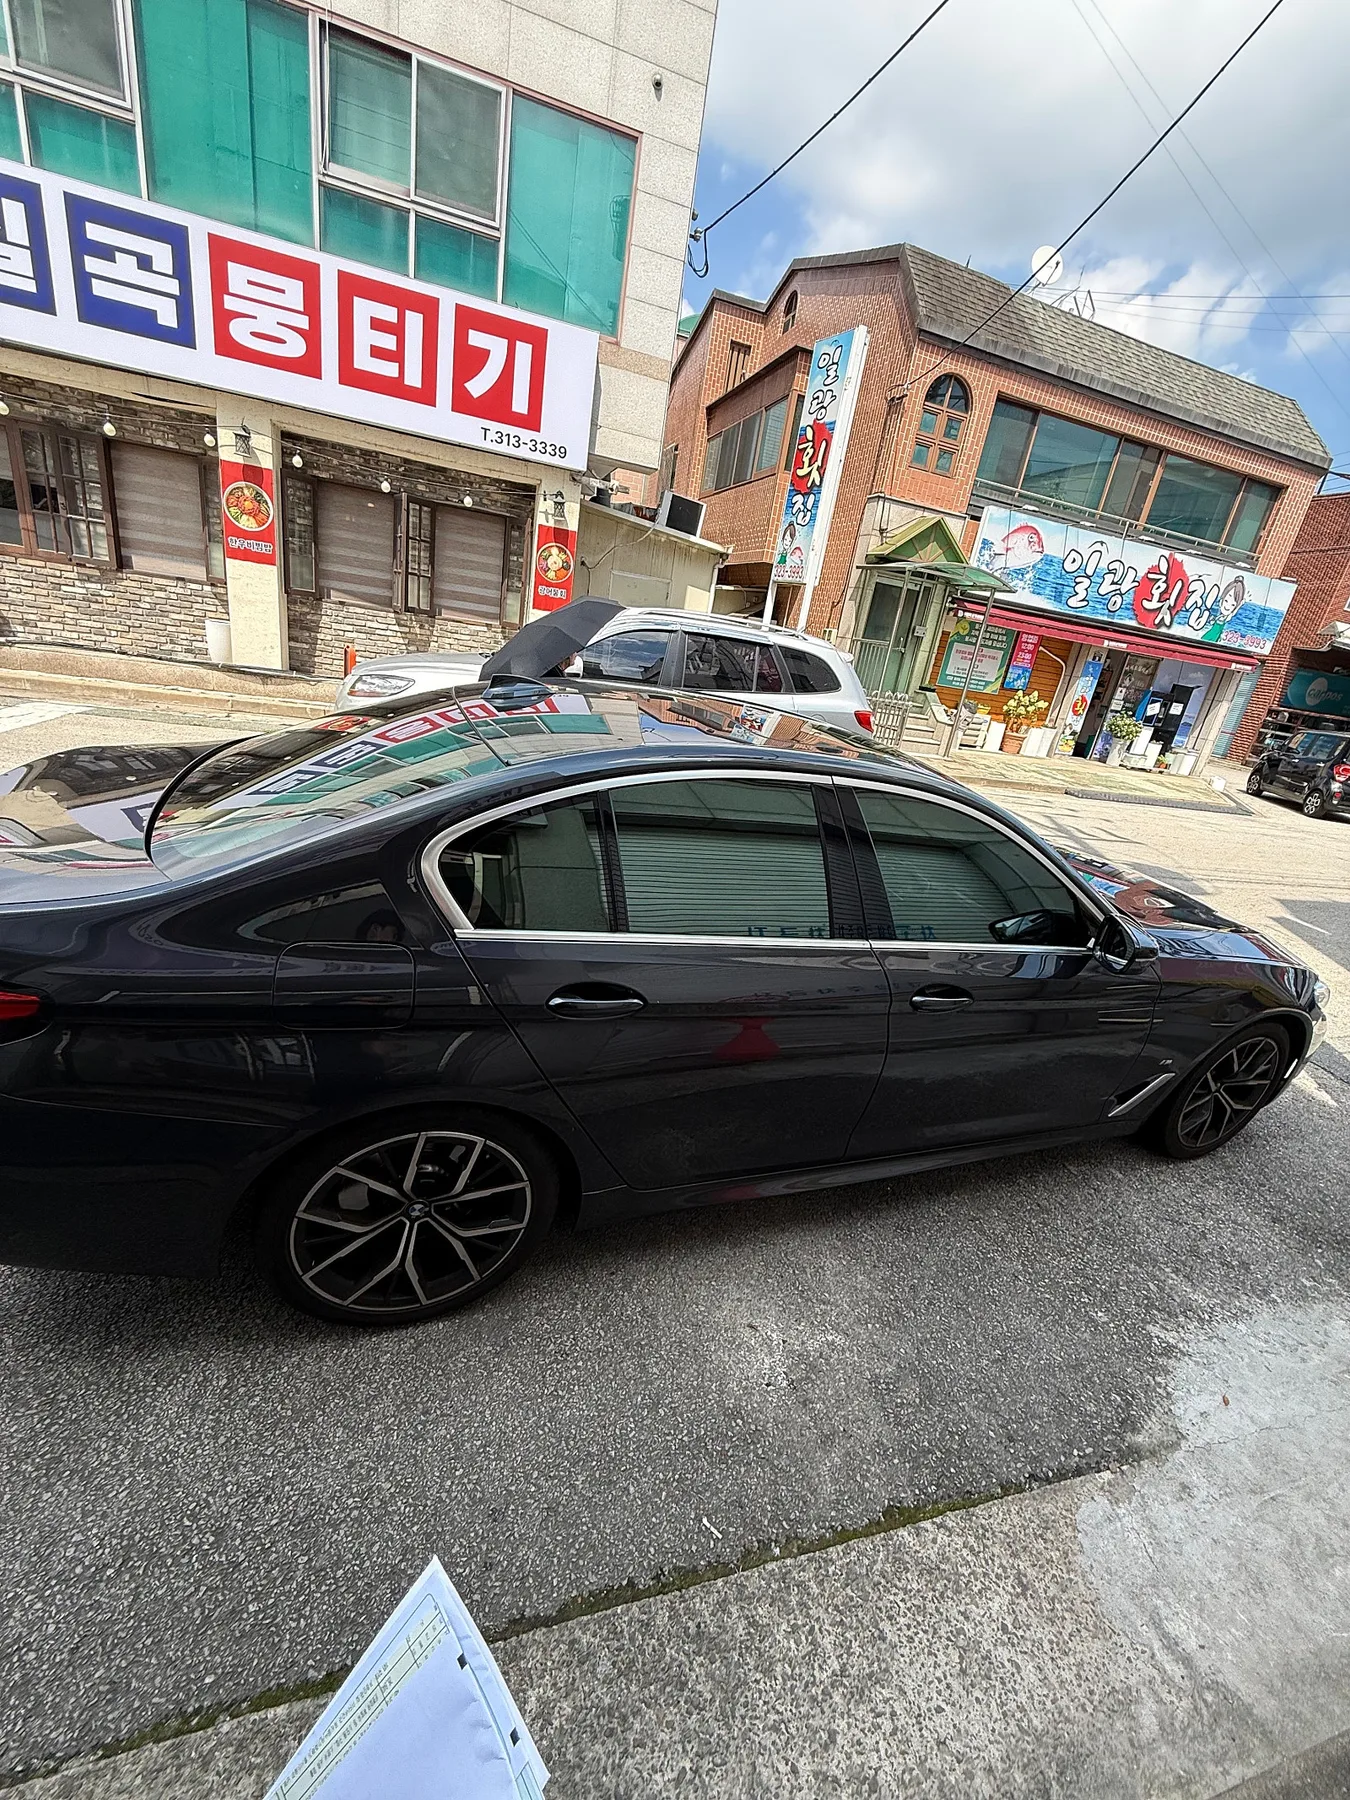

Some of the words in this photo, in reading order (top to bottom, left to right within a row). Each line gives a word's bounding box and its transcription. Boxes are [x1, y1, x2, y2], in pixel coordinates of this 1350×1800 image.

[480, 427, 568, 459] T.313-3339
[791, 345, 844, 527] 일광횟집
[228, 536, 273, 555] 한우비빔밥
[1062, 549, 1221, 631] 일광횟집
[1222, 631, 1268, 650] 323-3993
